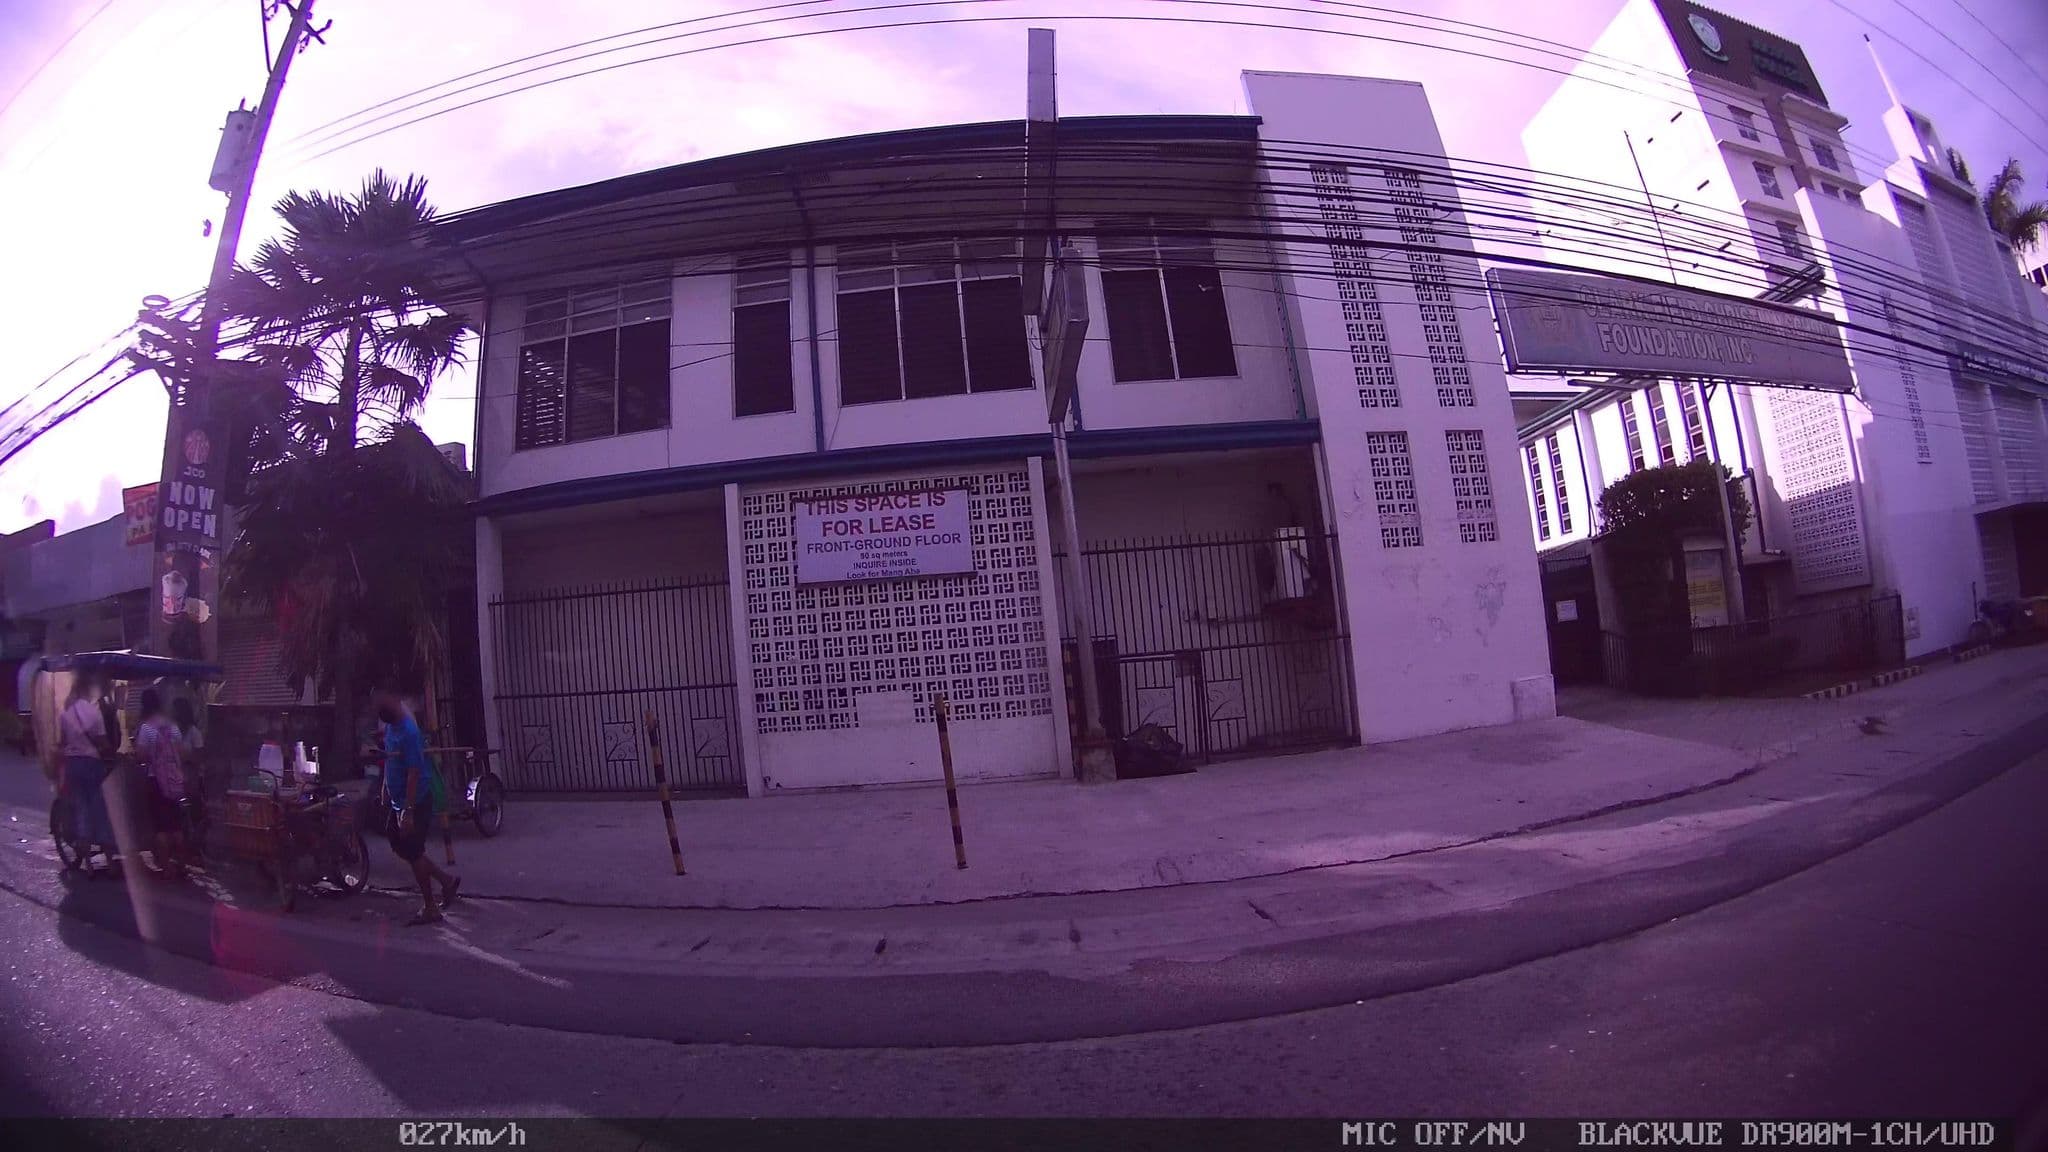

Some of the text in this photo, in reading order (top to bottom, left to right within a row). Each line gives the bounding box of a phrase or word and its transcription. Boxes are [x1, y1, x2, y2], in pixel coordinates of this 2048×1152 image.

[169, 482, 215, 510] NOW
[807, 491, 946, 516] THIS SPACE IS
[164, 506, 216, 538] OPEN
[822, 514, 936, 537] FOR LEASE
[807, 533, 962, 554] FRONT-GROUND FLOOR
[853, 559, 917, 570] INQUIRE INSIDE
